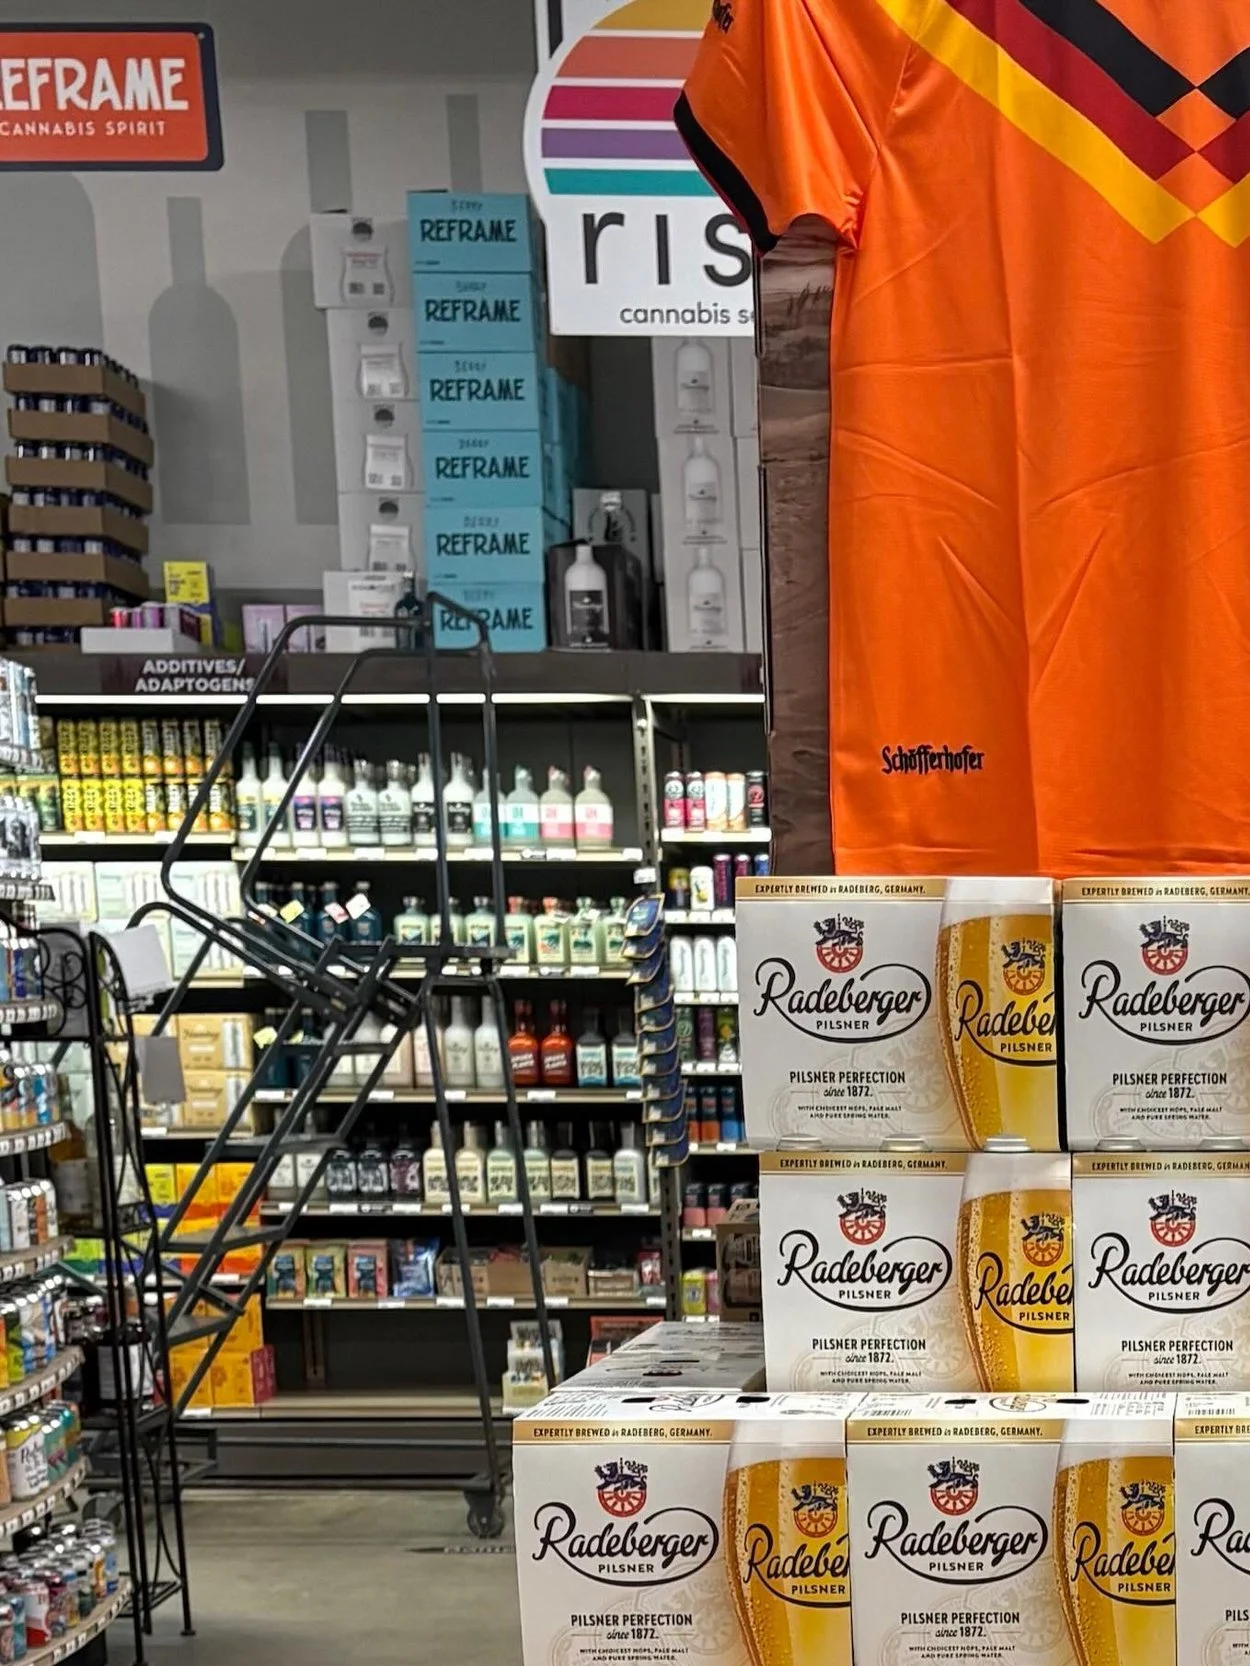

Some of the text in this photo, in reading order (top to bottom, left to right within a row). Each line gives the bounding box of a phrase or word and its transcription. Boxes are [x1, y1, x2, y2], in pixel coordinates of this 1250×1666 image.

[0, 58, 189, 111] EFRAME
[0, 121, 165, 136] CANNABIS SPIRIT
[420, 219, 516, 243] REFRAME
[425, 299, 521, 321] REFRAME
[619, 301, 731, 325] cannabis
[430, 378, 525, 401] REFRAME
[435, 456, 530, 479] REFRAME
[436, 533, 530, 556] REFRAME
[143, 659, 245, 674] ADDITIVES/
[882, 745, 984, 774] Schöfferhofer
[754, 957, 922, 1025] Radeberger
[1079, 960, 1246, 1027] Radeberger
[1140, 1022, 1193, 1031] PILSNER
[777, 1230, 943, 1295] Radeberger
[1088, 1232, 1250, 1296] Radeberger
[533, 1428, 574, 1438] EXPERTLY
[576, 1428, 610, 1438] BREWED
[621, 1428, 668, 1439] RADEBERG,
[670, 1428, 713, 1438] GERMANY.
[532, 1502, 710, 1569] Radeberger
[865, 1500, 1038, 1567] Radeberger
[598, 1564, 654, 1573] PILSNER
[571, 1614, 692, 1627] PILSNER PERFECTION
[606, 1628, 659, 1641] since 1872.
